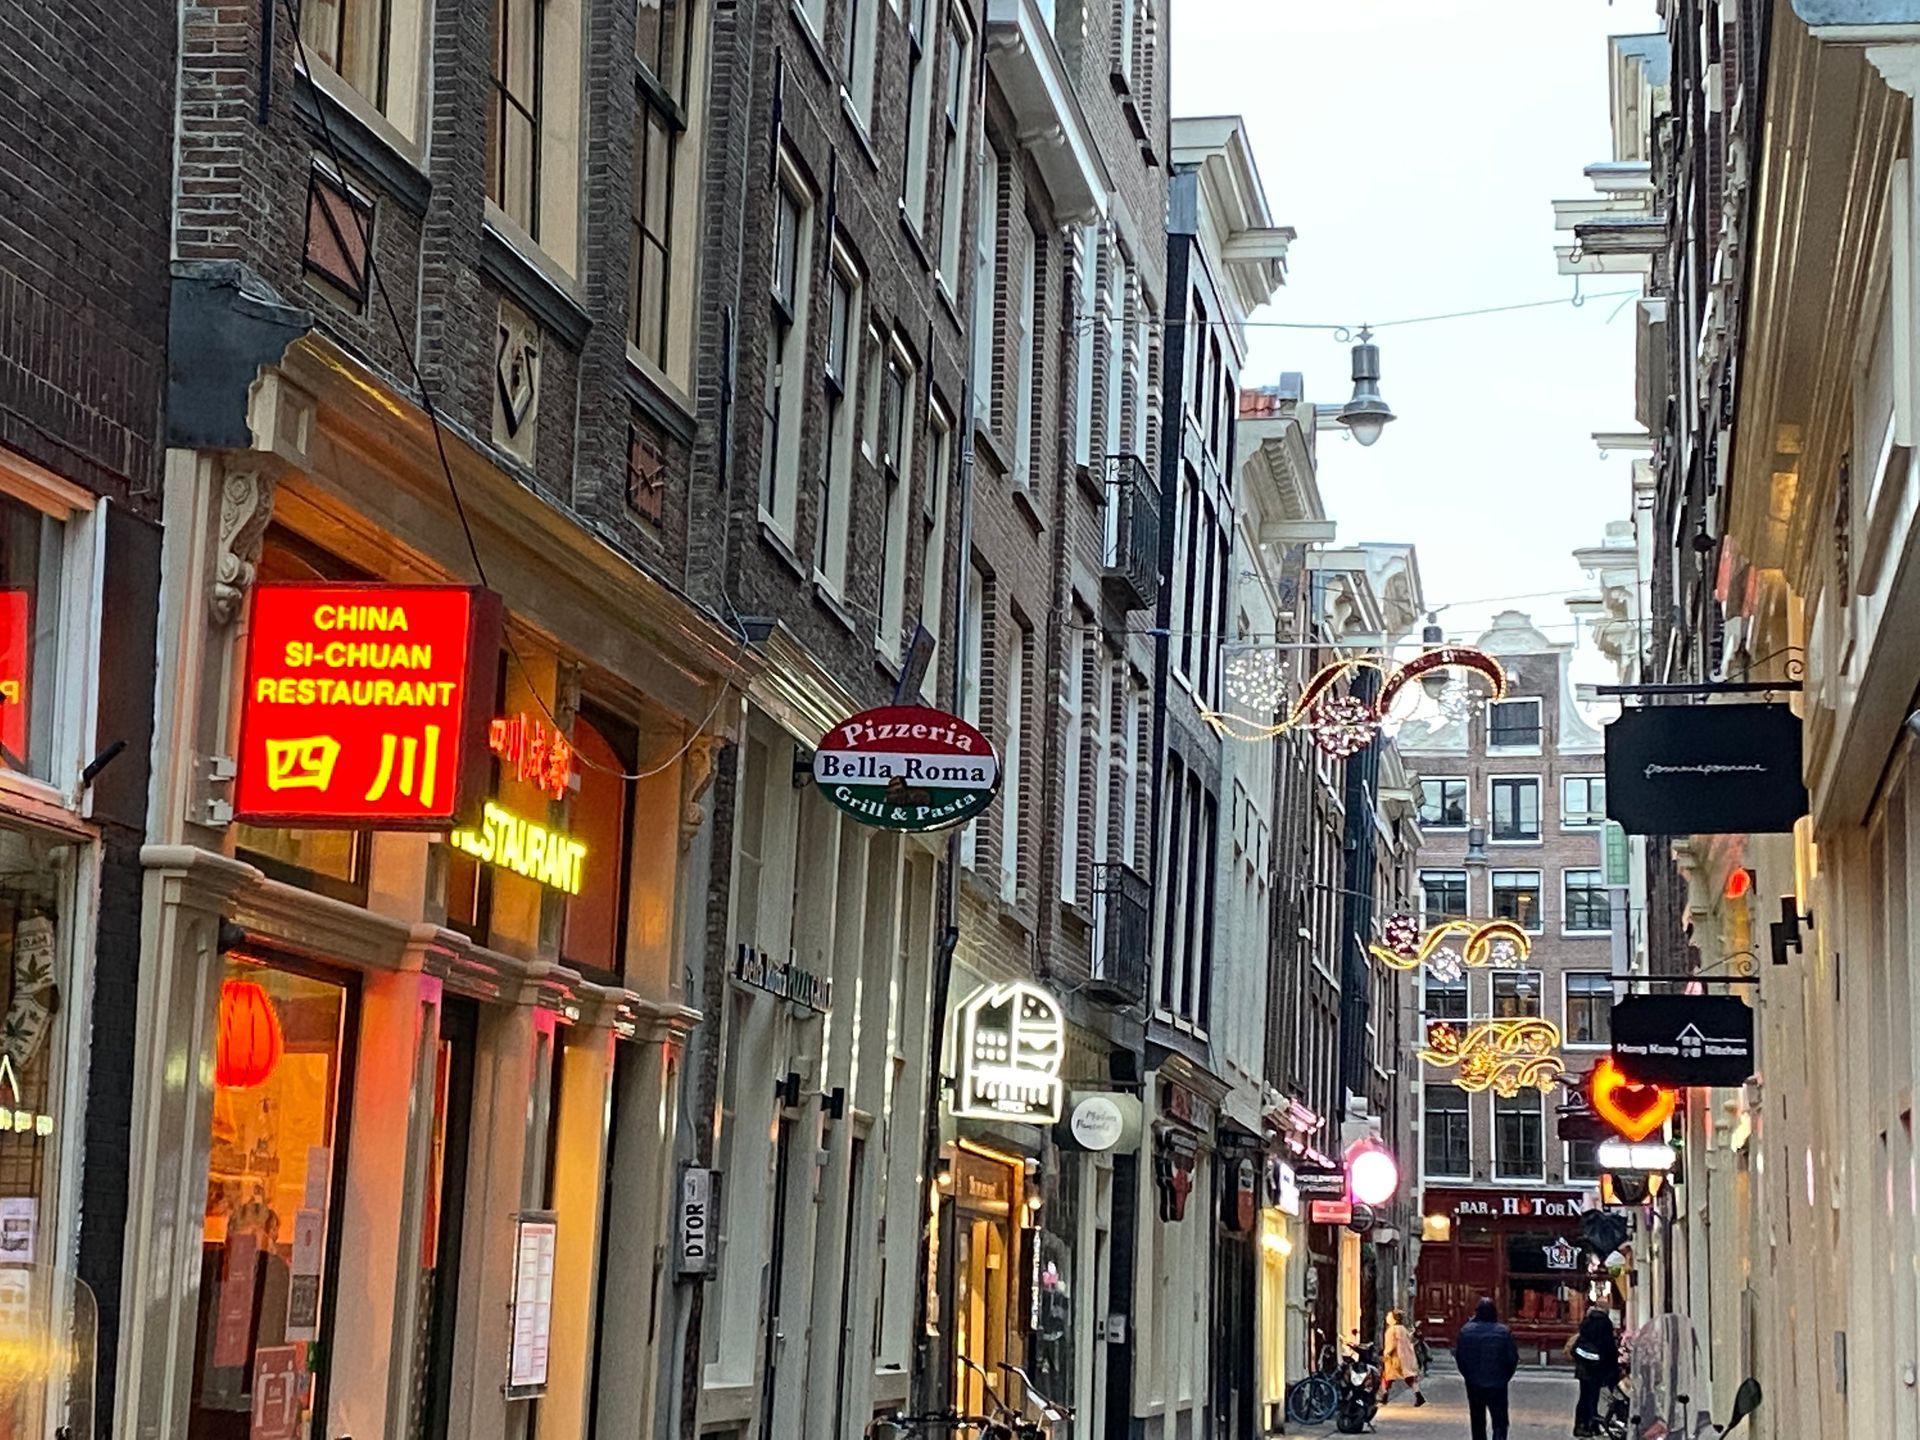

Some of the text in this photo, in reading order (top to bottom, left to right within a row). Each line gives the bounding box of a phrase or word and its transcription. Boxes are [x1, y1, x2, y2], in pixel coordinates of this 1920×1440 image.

[313, 605, 408, 631] CHINA
[285, 641, 432, 670] SI-CHUAN
[257, 677, 456, 707] RESTAURANT
[840, 719, 973, 752] Pizzeria
[265, 724, 440, 808] 四川
[822, 755, 986, 782] Bella Roma
[835, 785, 977, 821] Grill & Pasta
[451, 802, 587, 896] STAURANT
[1617, 1043, 1648, 1055] Hong
[1649, 1044, 1679, 1055] Kong
[1705, 1045, 1747, 1055] Kitchen
[1460, 1202, 1488, 1214] BAR
[686, 1203, 704, 1256] DTOR
